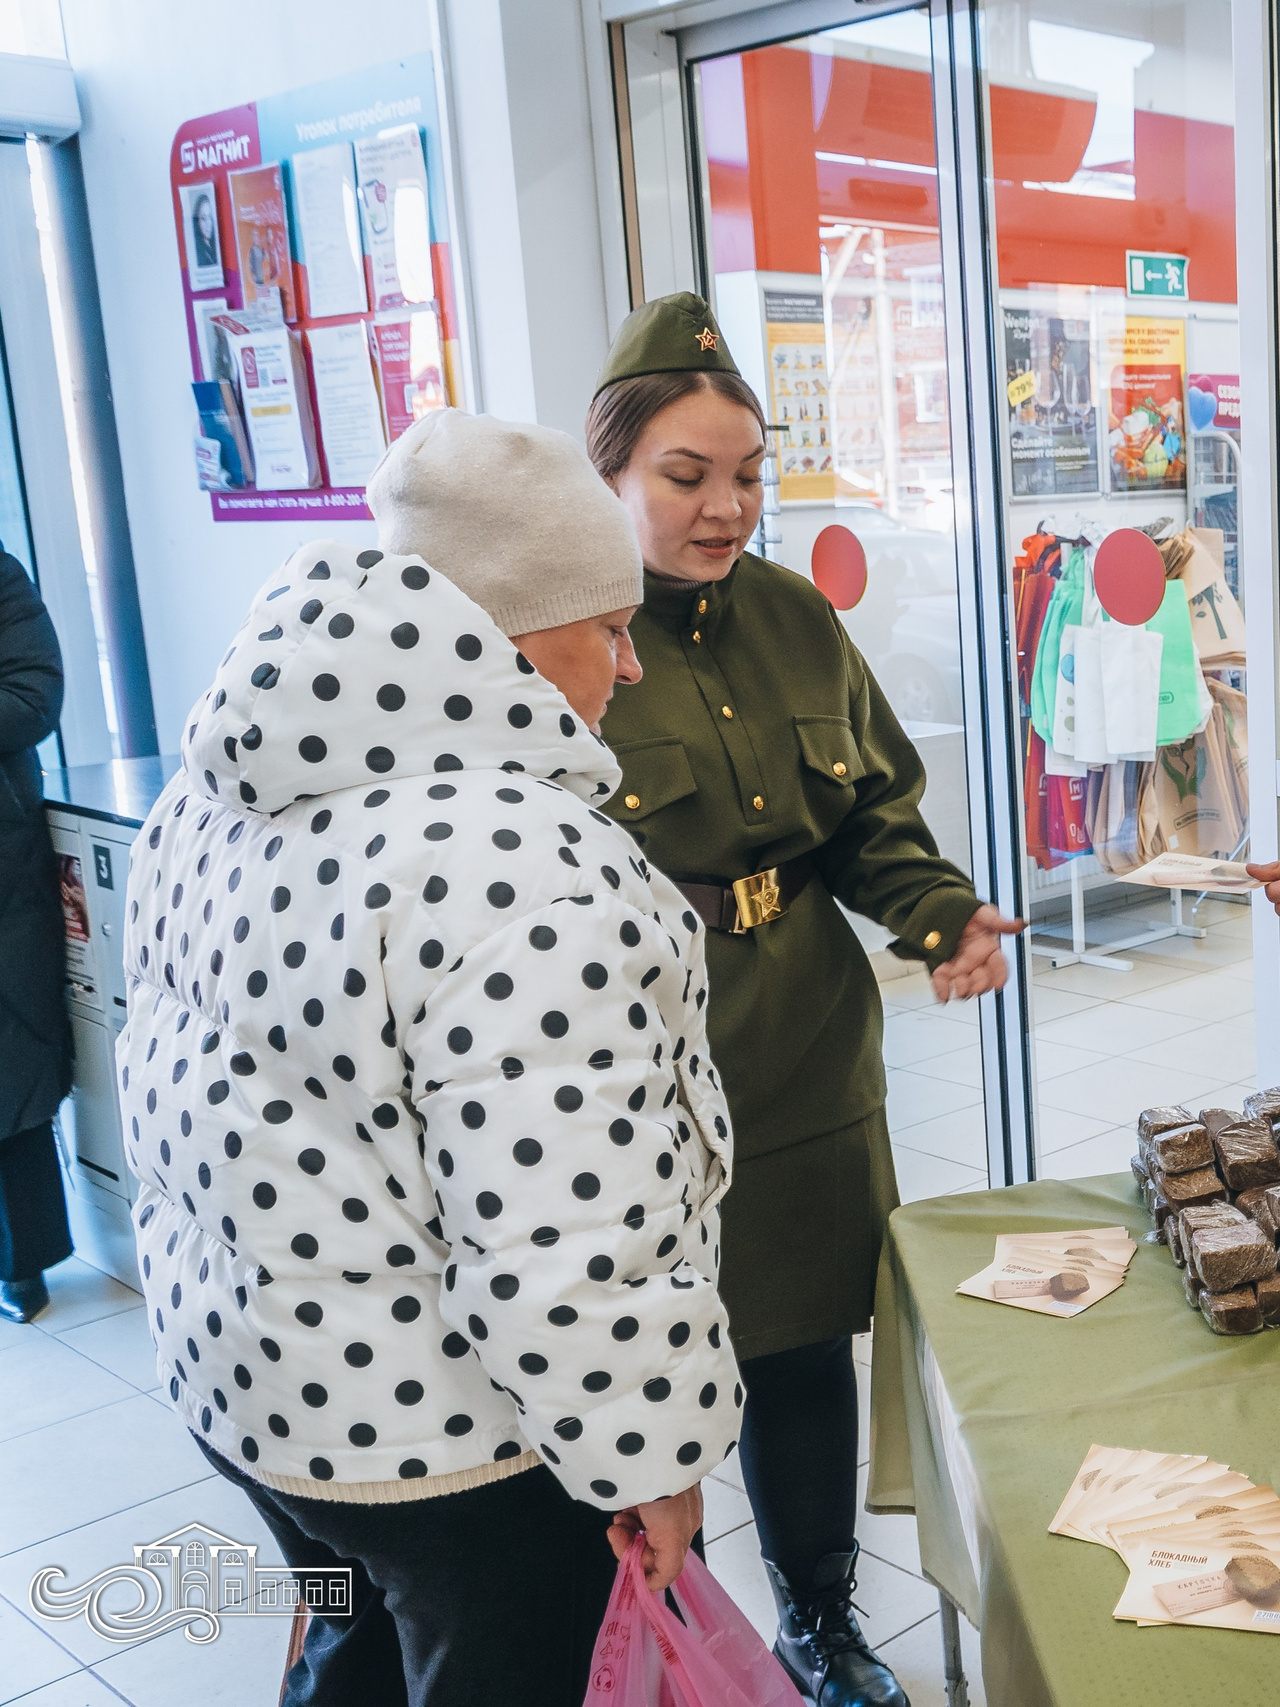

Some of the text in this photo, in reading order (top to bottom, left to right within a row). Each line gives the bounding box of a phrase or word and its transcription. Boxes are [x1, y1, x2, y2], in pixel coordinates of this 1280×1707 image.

[339, 96, 422, 134] потребителя
[197, 135, 250, 170] МАГНИТ
[98, 855, 109, 880] 3
[1148, 1558, 1171, 1568] ХЛЕБ
[1151, 1550, 1208, 1565] БЛОКАДНЫЙ
[1177, 1575, 1222, 1590] КАРТОЧКА
